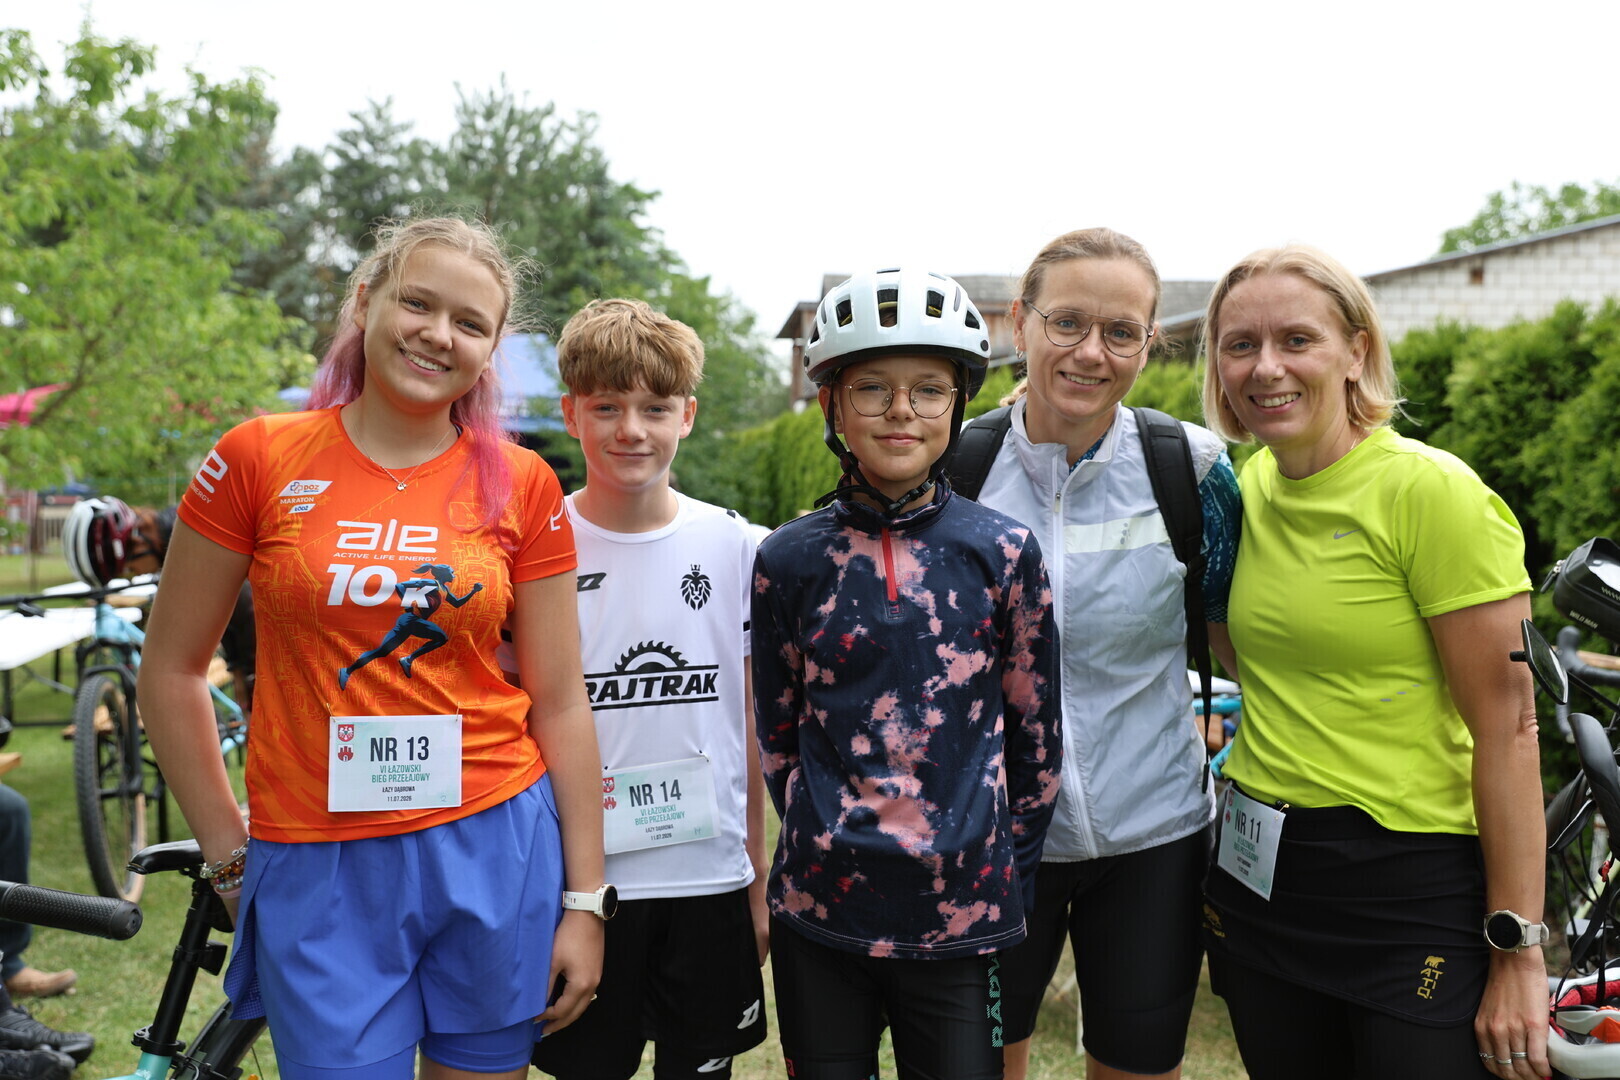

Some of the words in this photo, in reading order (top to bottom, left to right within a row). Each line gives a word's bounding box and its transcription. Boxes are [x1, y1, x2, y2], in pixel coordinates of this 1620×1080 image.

[336, 518, 439, 553] ale
[370, 737, 398, 762] NR
[406, 736, 430, 761] 13
[371, 774, 387, 783] BIEG
[388, 773, 431, 783] PRZEŁAJOWY
[379, 765, 387, 773] VI
[388, 764, 422, 773] ŁAZOWSKI
[628, 783, 654, 807] NR
[660, 779, 682, 802] 14
[634, 816, 649, 826] BIEG
[649, 811, 685, 823] PRZEŁAJOWY
[647, 804, 677, 816] ŁAZOWSKI
[1234, 808, 1247, 836] NR
[1250, 817, 1262, 843] 11
